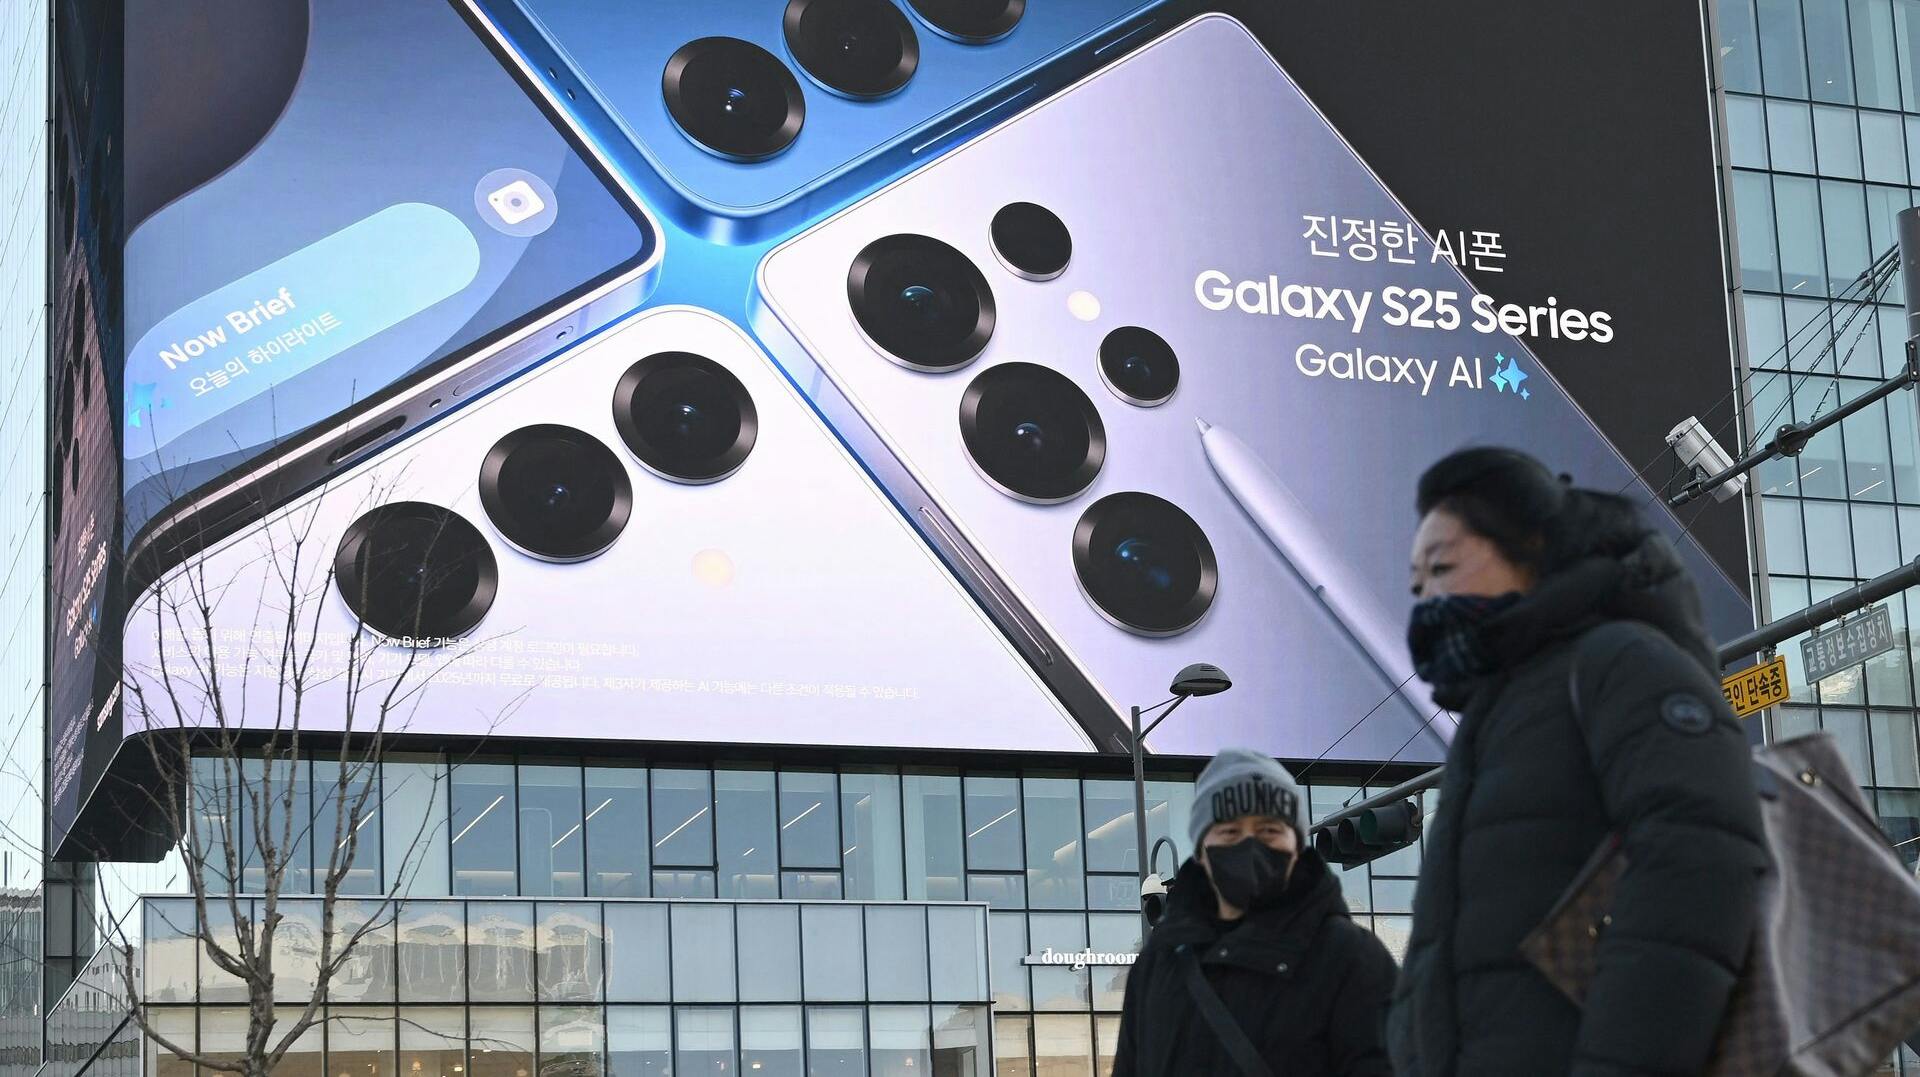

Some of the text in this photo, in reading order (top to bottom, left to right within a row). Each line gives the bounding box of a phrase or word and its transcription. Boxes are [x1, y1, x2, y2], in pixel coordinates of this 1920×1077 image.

[1302, 214, 1507, 273] 진정한 AI폰
[159, 286, 296, 370] Now Brief
[1194, 270, 1614, 343] Galaxy S25 Series
[189, 312, 342, 397] 오늘의 하이라이트
[1295, 343, 1483, 396] Galaxy AI
[371, 635, 401, 648] Now
[402, 635, 431, 648] Brief
[1807, 614, 1889, 673] 교통정보수집장치
[1746, 667, 1782, 706] 단속중
